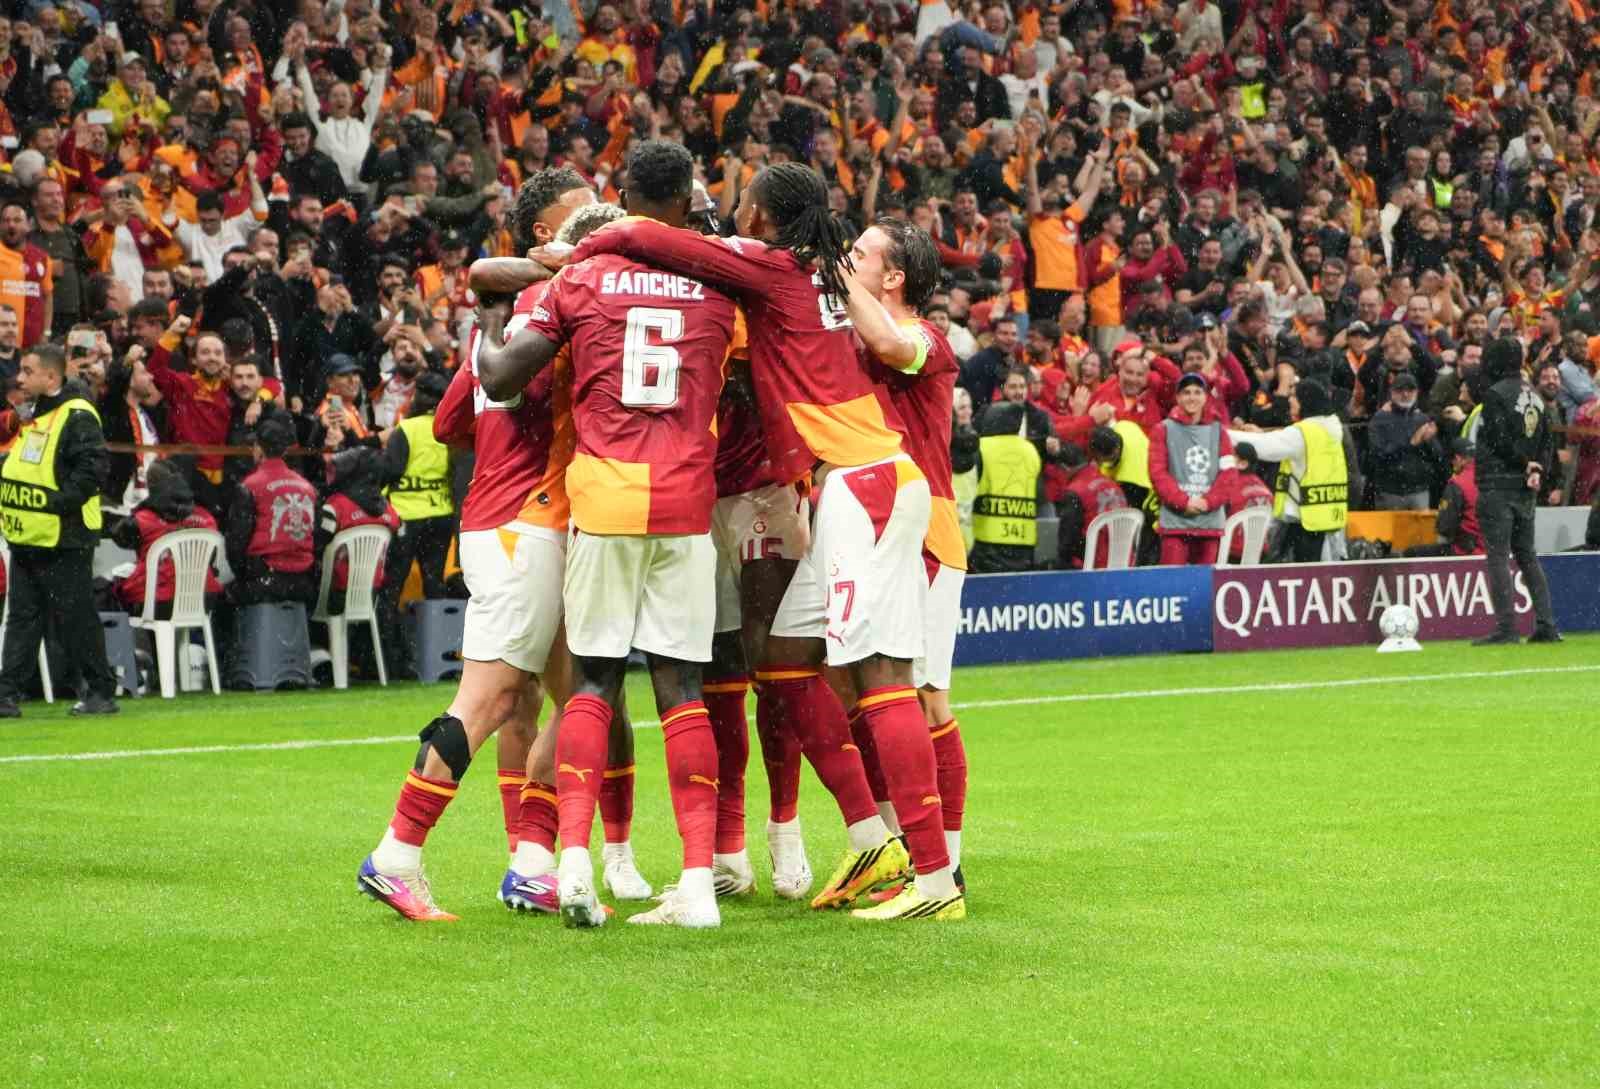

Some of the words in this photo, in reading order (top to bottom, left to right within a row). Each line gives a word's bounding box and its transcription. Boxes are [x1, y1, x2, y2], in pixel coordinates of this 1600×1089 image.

[601, 271, 705, 300] SANCHEZ
[621, 306, 684, 407] 6
[0, 483, 48, 508] WARD
[981, 497, 1037, 517] STEWAR
[1307, 485, 1348, 504] STEW
[957, 601, 1086, 635] HAMPIONS
[1093, 596, 1184, 627] LEAGUE
[1215, 577, 1357, 637] QATAR
[1367, 570, 1533, 621] AIRWAS
